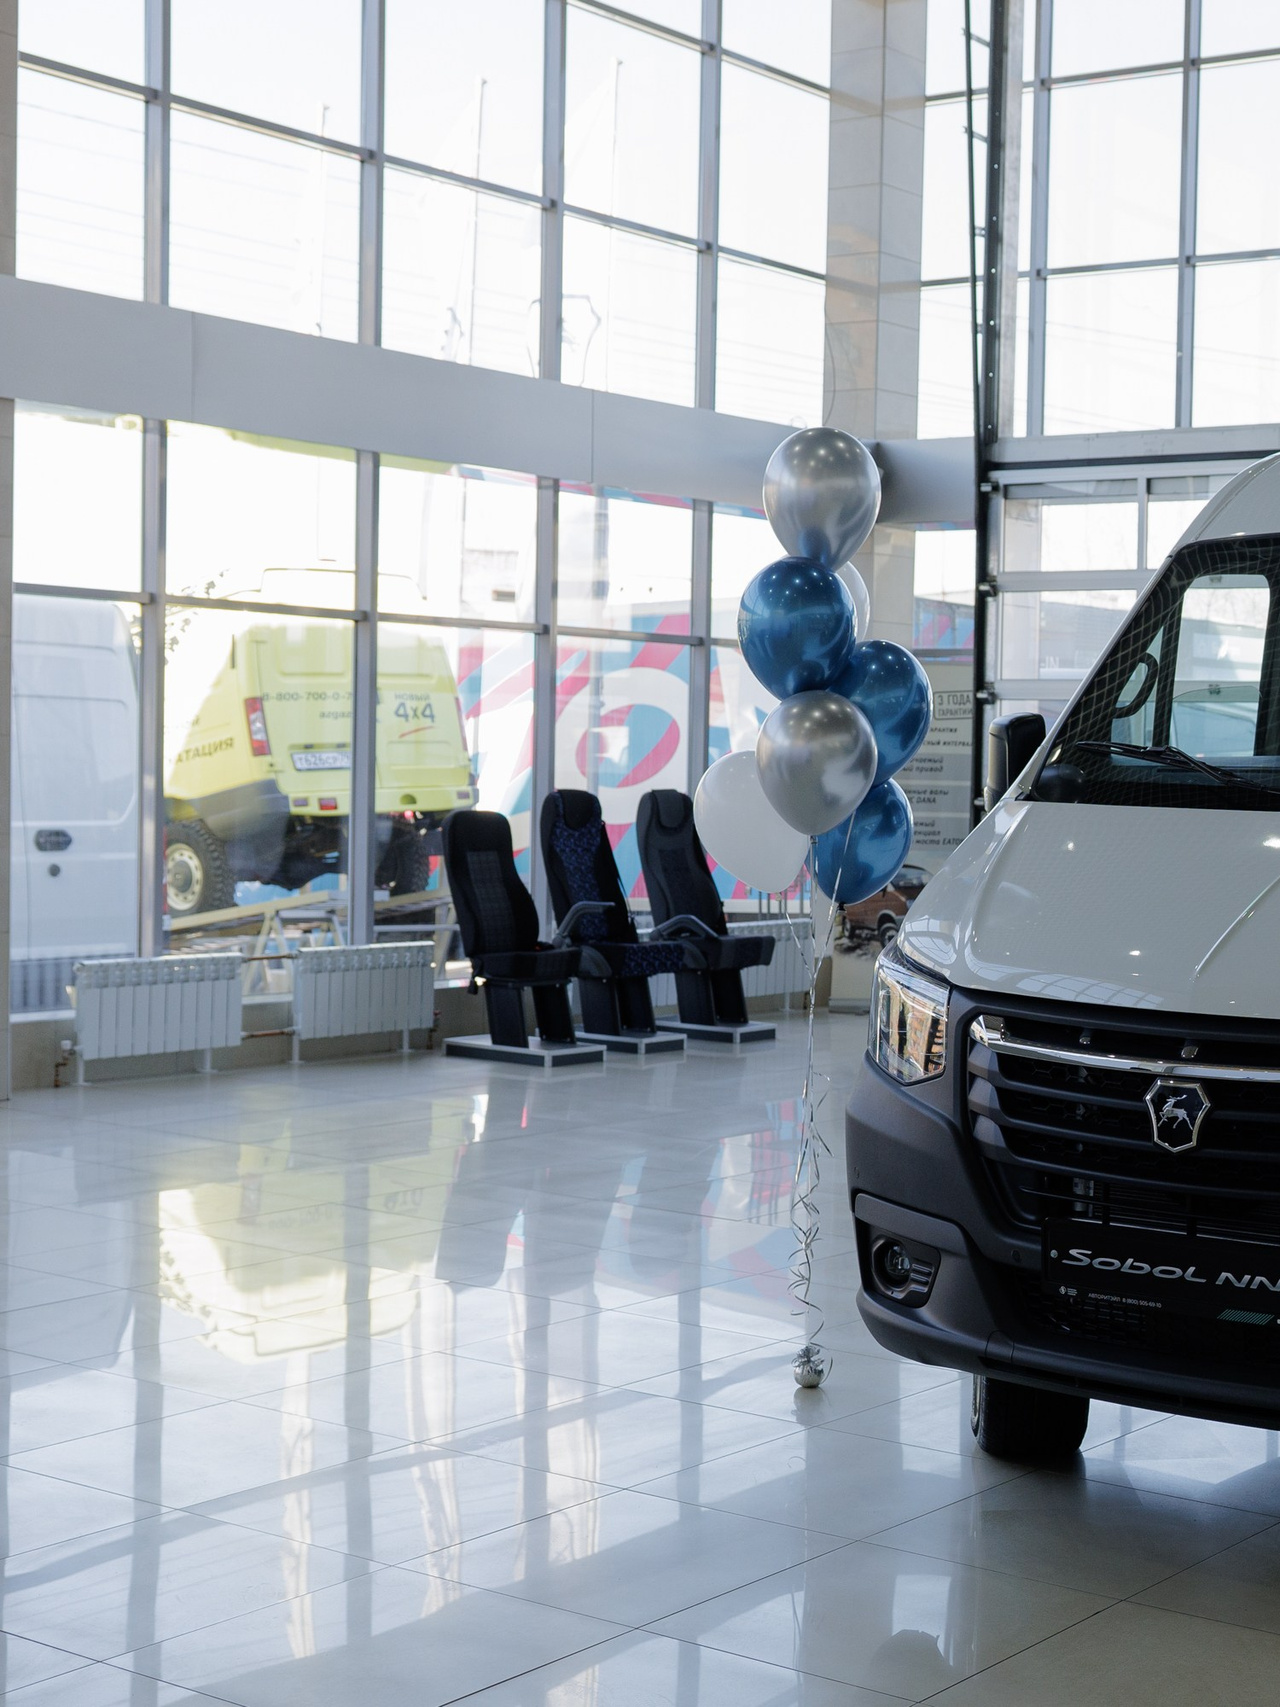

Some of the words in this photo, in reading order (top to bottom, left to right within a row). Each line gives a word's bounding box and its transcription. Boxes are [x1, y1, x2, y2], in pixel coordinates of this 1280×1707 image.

[262, 691, 353, 702] 8-800-700-0-7
[947, 694, 972, 706] ГОДА
[177, 737, 236, 764] АТАЦИЯ
